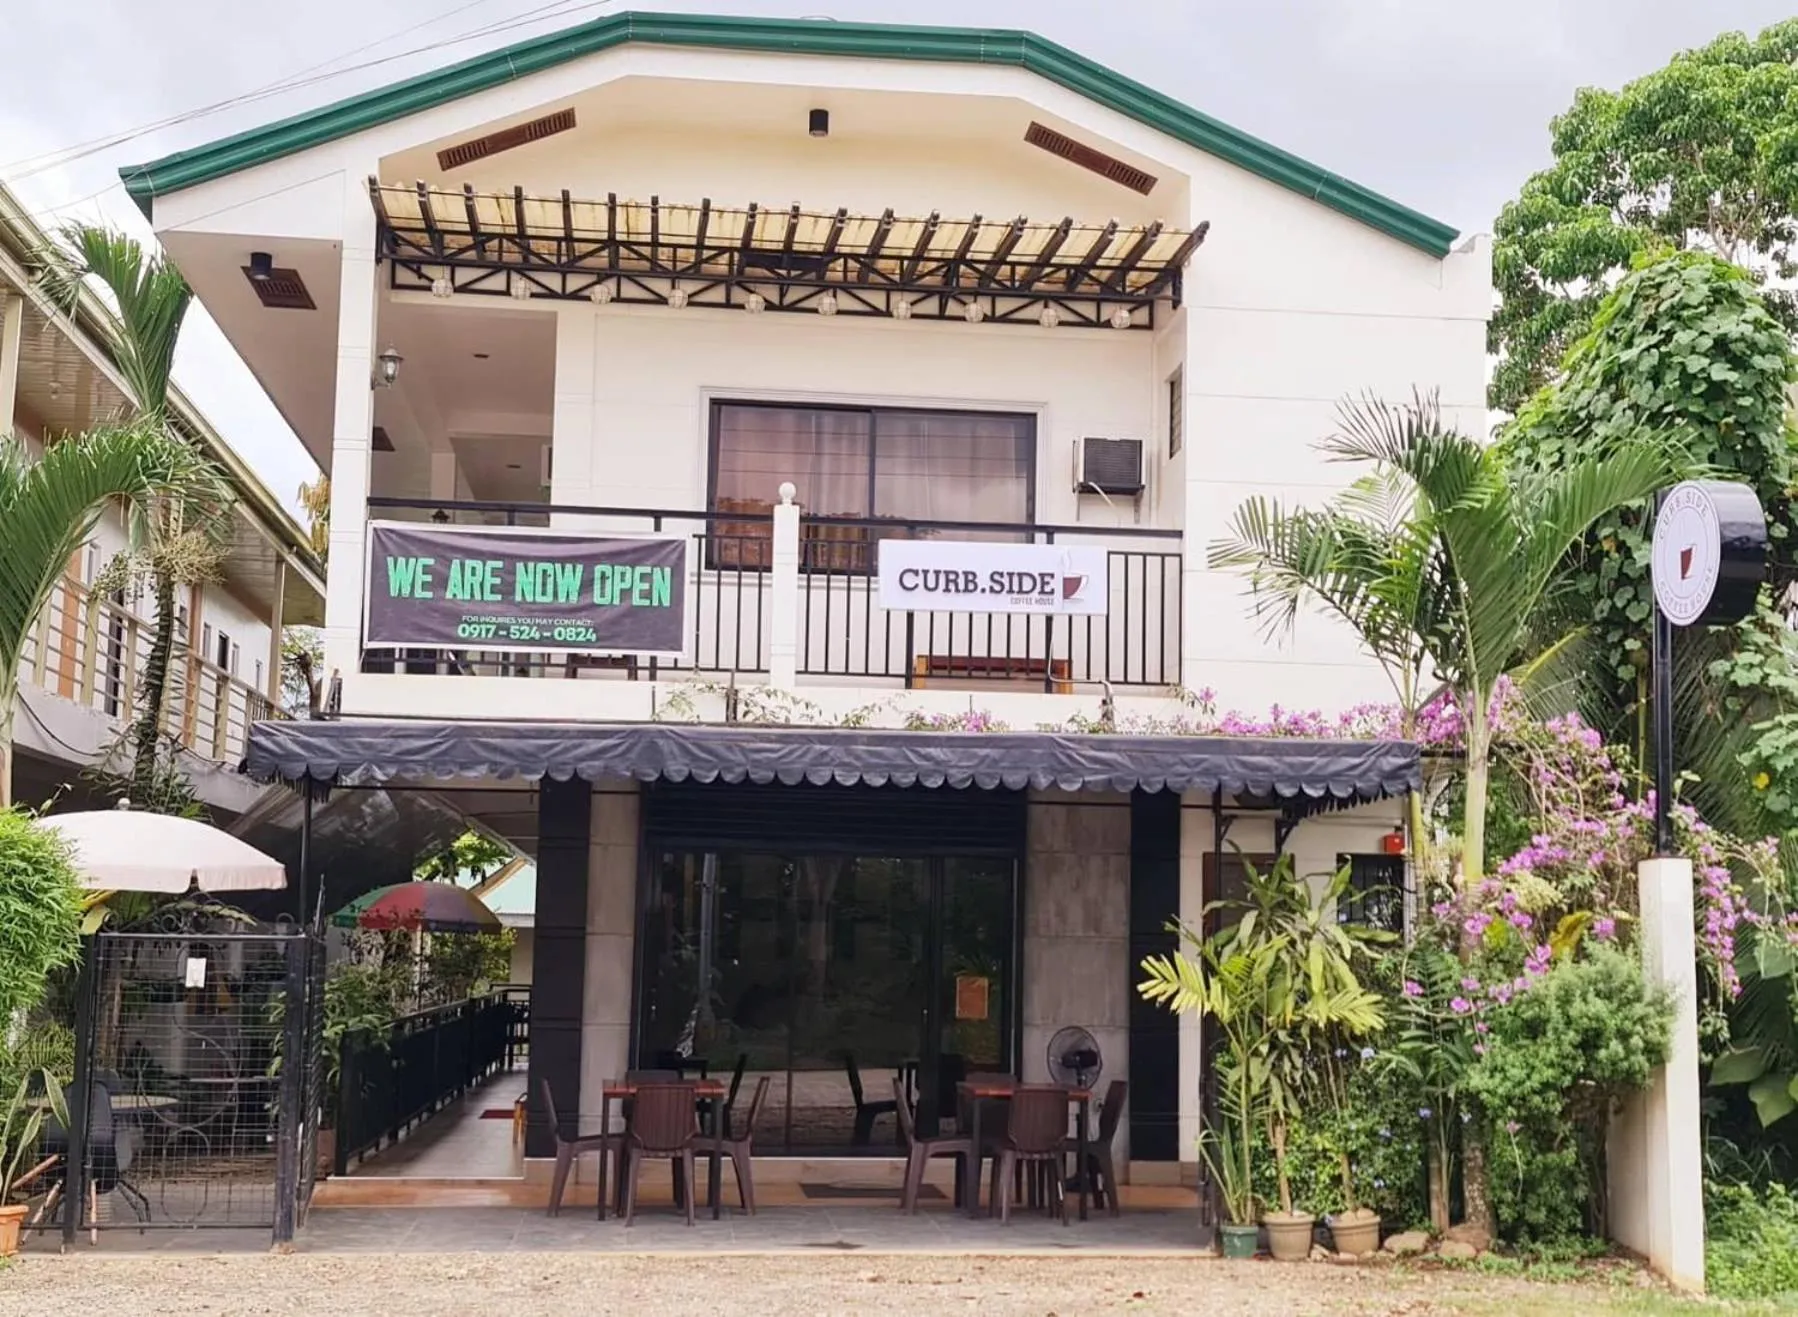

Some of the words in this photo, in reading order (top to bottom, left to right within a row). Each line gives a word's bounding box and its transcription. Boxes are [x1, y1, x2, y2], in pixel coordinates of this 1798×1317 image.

[386, 556, 435, 598] WE
[445, 559, 503, 601] ARE
[515, 561, 583, 604] NOW
[593, 564, 671, 607] OPEN
[899, 567, 1055, 595] CURB.SIDE
[462, 615, 478, 623] FOR
[517, 617, 534, 625] YOU
[457, 624, 496, 639] 0917
[509, 626, 541, 640] 524
[553, 627, 597, 642] 0824
